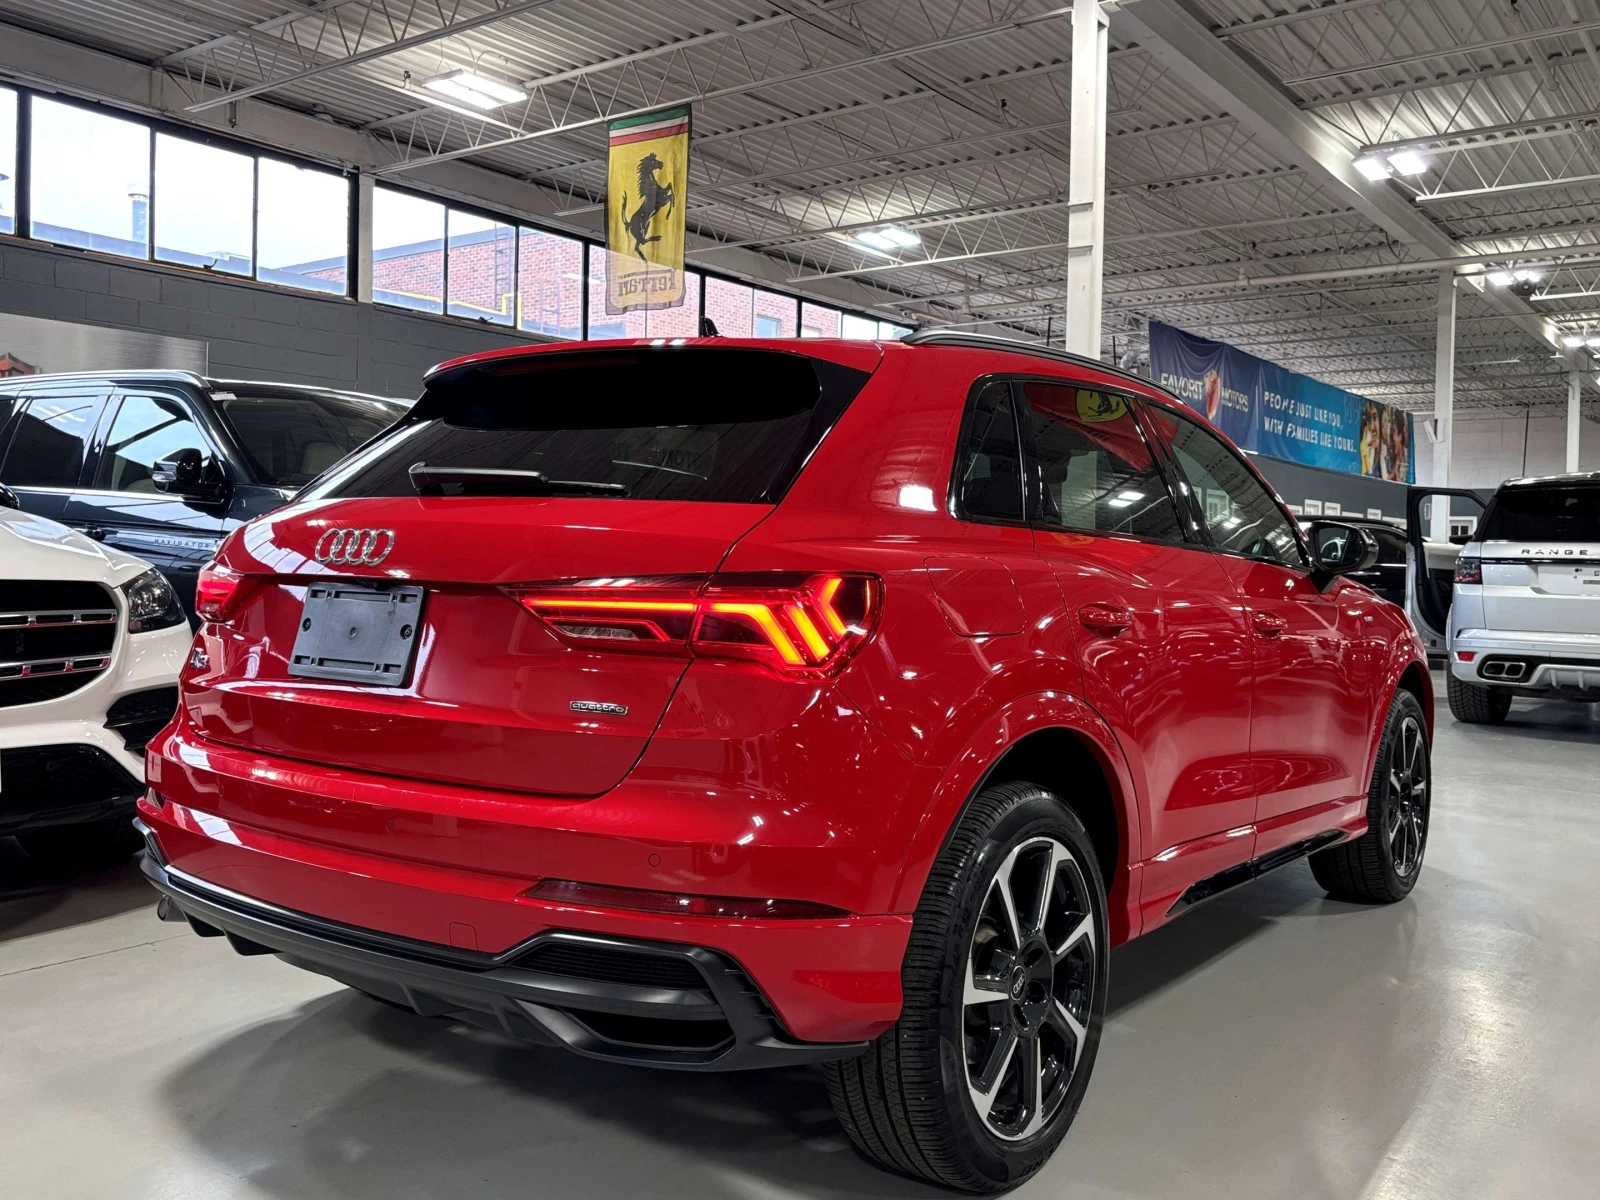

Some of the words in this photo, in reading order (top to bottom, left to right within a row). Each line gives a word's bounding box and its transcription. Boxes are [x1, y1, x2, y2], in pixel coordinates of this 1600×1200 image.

[1161, 373, 1203, 400] FAVORIT
[1221, 387, 1248, 412] MOTORS
[1295, 402, 1312, 419] JUST
[1314, 407, 1328, 424] LIKE
[1264, 416, 1284, 435] WITH
[1286, 423, 1318, 444] FAMILIES
[1320, 432, 1332, 448] LIKE
[154, 538, 210, 548] NAVIGATOR
[572, 703, 625, 713] quattro
